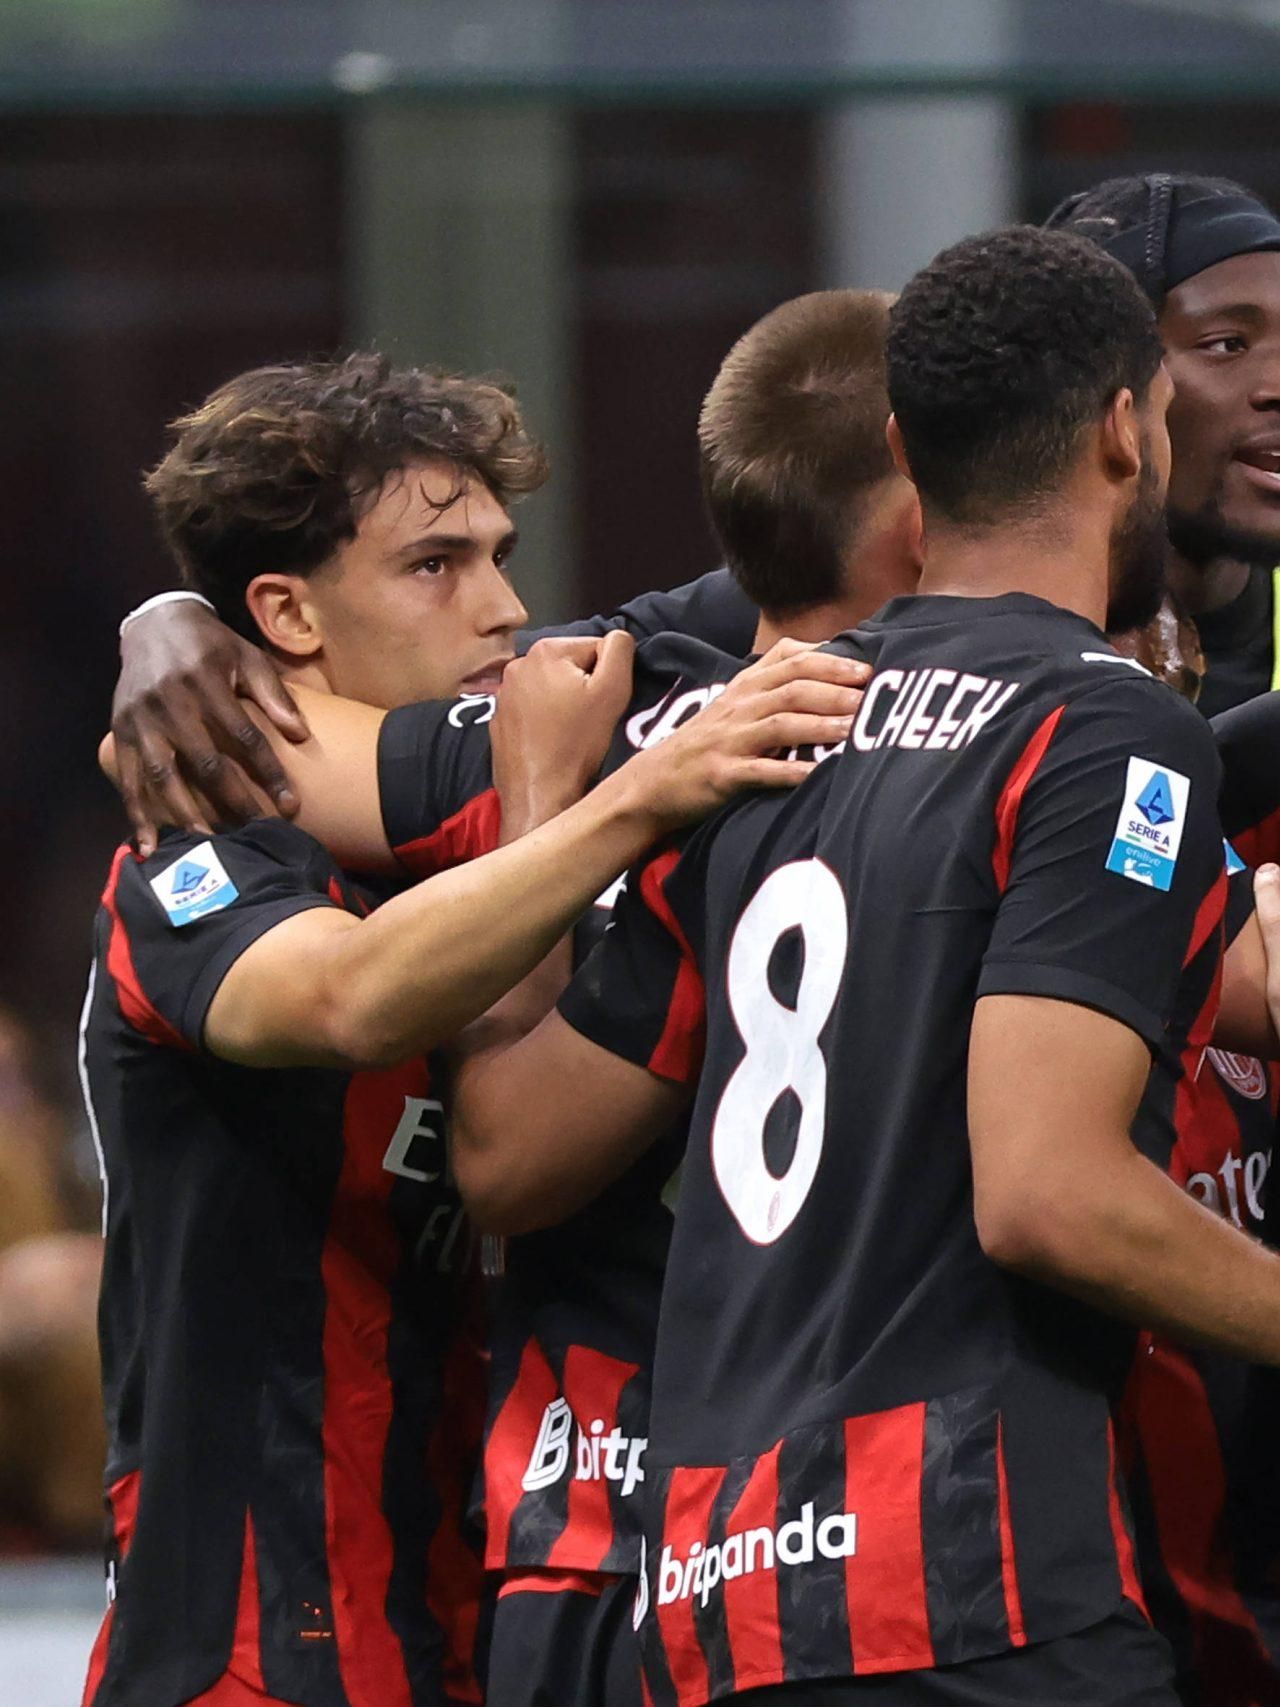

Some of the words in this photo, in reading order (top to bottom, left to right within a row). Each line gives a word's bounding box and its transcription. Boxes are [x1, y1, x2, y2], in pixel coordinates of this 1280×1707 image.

[1128, 820, 1161, 842] SERIE
[1162, 835, 1170, 847] A
[711, 856, 849, 1246] 8
[658, 1501, 857, 1609] bitpanda
